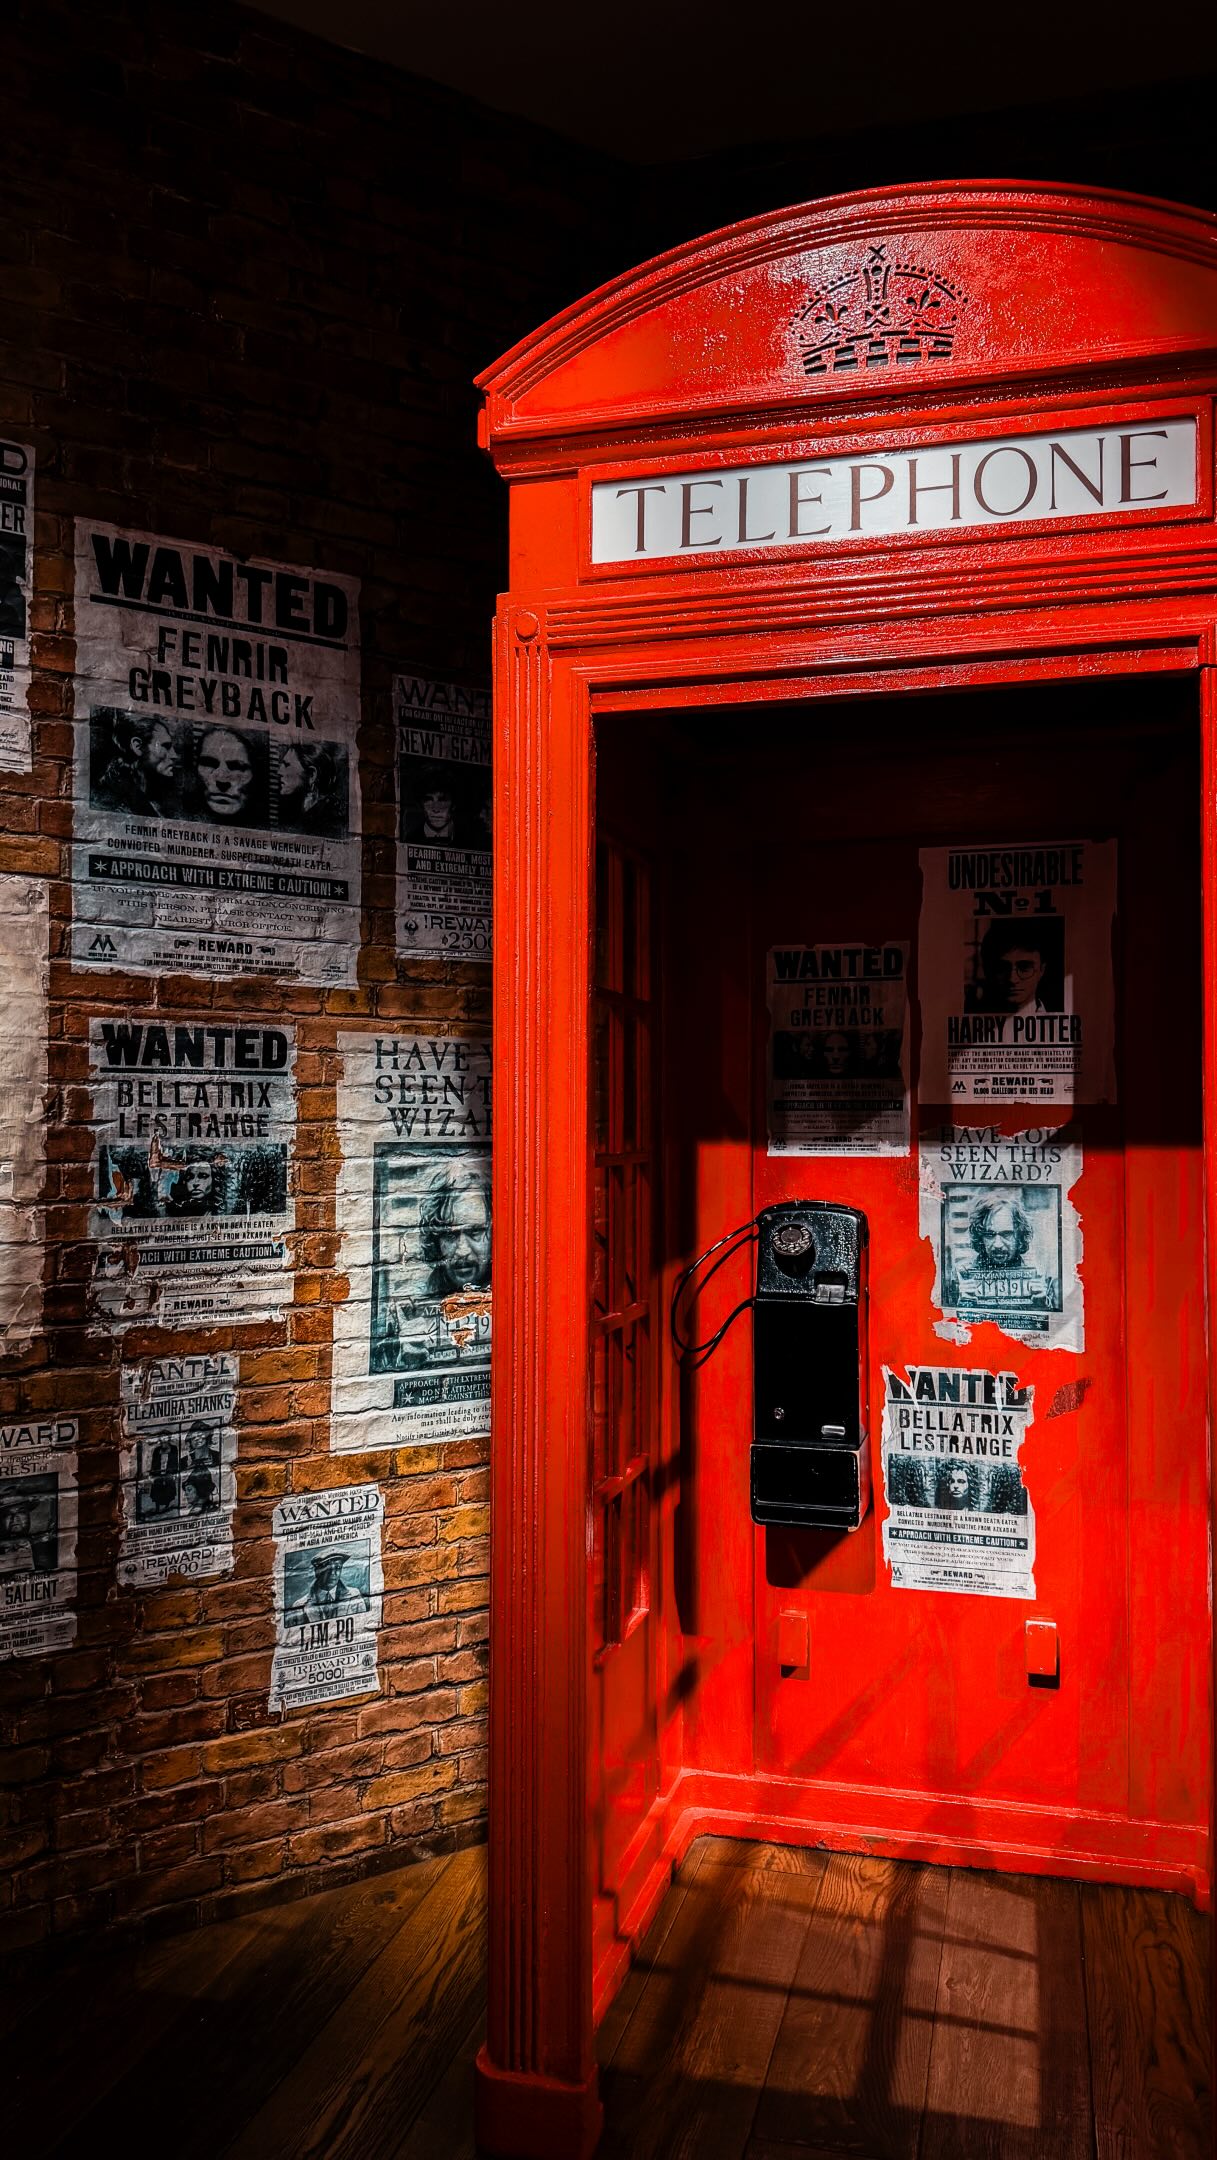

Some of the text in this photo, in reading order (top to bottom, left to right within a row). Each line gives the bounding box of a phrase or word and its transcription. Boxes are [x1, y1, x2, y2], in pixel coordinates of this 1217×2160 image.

[616, 430, 1168, 552] TELEPHONE
[92, 534, 347, 638] WANTED
[158, 626, 288, 685] FENRIR
[129, 667, 315, 730] GREYBACK
[126, 825, 267, 850] FENRIR GREYBACK IS A SAVAGE
[107, 838, 159, 852] CONVICTED
[221, 851, 269, 864] SUSPECTED
[408, 848, 440, 859] BEARING
[416, 860, 431, 870] AND
[435, 861, 477, 874] EXTREMELY
[949, 848, 1084, 889] UNDESIRABLE
[111, 860, 331, 896] APPROACH WITH EXTREME CAUTION!
[108, 886, 131, 895] YOU
[136, 888, 170, 898] HAVE
[172, 892, 197, 900] ANY
[278, 902, 344, 914] CONCERNING
[155, 914, 211, 925] NEAREST
[246, 911, 294, 921] CONTACT
[199, 939, 252, 954] REWARD
[774, 948, 903, 978] WANTED
[805, 986, 870, 1006] FENRIR
[791, 1008, 884, 1026] GREYBACK
[948, 1015, 1082, 1043] HARRY POTTER
[102, 1024, 288, 1069] WANTED
[375, 1039, 470, 1071] HAVE
[375, 1075, 466, 1105] SEEN
[992, 1077, 1035, 1086] REWARD
[117, 1080, 271, 1108] BELLATRIX
[119, 1113, 269, 1138] LESTRANGE
[940, 1126, 1000, 1144] HAVE
[941, 1146, 1062, 1163] SEEN THIS
[948, 1164, 1053, 1181] WIZARD?
[151, 1223, 188, 1232] LESTRANGE
[191, 1223, 197, 1231] IS
[223, 1232, 239, 1240] FROM
[164, 1249, 186, 1262] WITH
[190, 1248, 230, 1260] EXTREME
[174, 1299, 214, 1309] REWARD
[400, 1379, 439, 1390] APPROACH
[451, 1384, 481, 1393] ATTEMPT
[128, 1394, 231, 1421] ELEANDRA SHANKS
[392, 1415, 405, 1424] Any
[407, 1411, 446, 1420] information
[448, 1408, 471, 1416] leading
[436, 1417, 451, 1425] shall
[899, 1408, 1014, 1435] BELLATRIX
[900, 1431, 1012, 1457] LESTRANGE
[279, 1494, 379, 1522] WANTED
[897, 1510, 923, 1518] BELLATRIX
[924, 1512, 952, 1520] LESTRANGE
[898, 1518, 924, 1526] CONVICTED
[334, 1532, 358, 1541] AMERICA
[898, 1530, 932, 1540] APPROACH
[934, 1532, 951, 1542] WITH
[953, 1533, 984, 1544] EXTREME
[943, 1570, 973, 1578] REWARD
[5, 1579, 59, 1605] SALIENT
[300, 1617, 353, 1652] LIM PO
